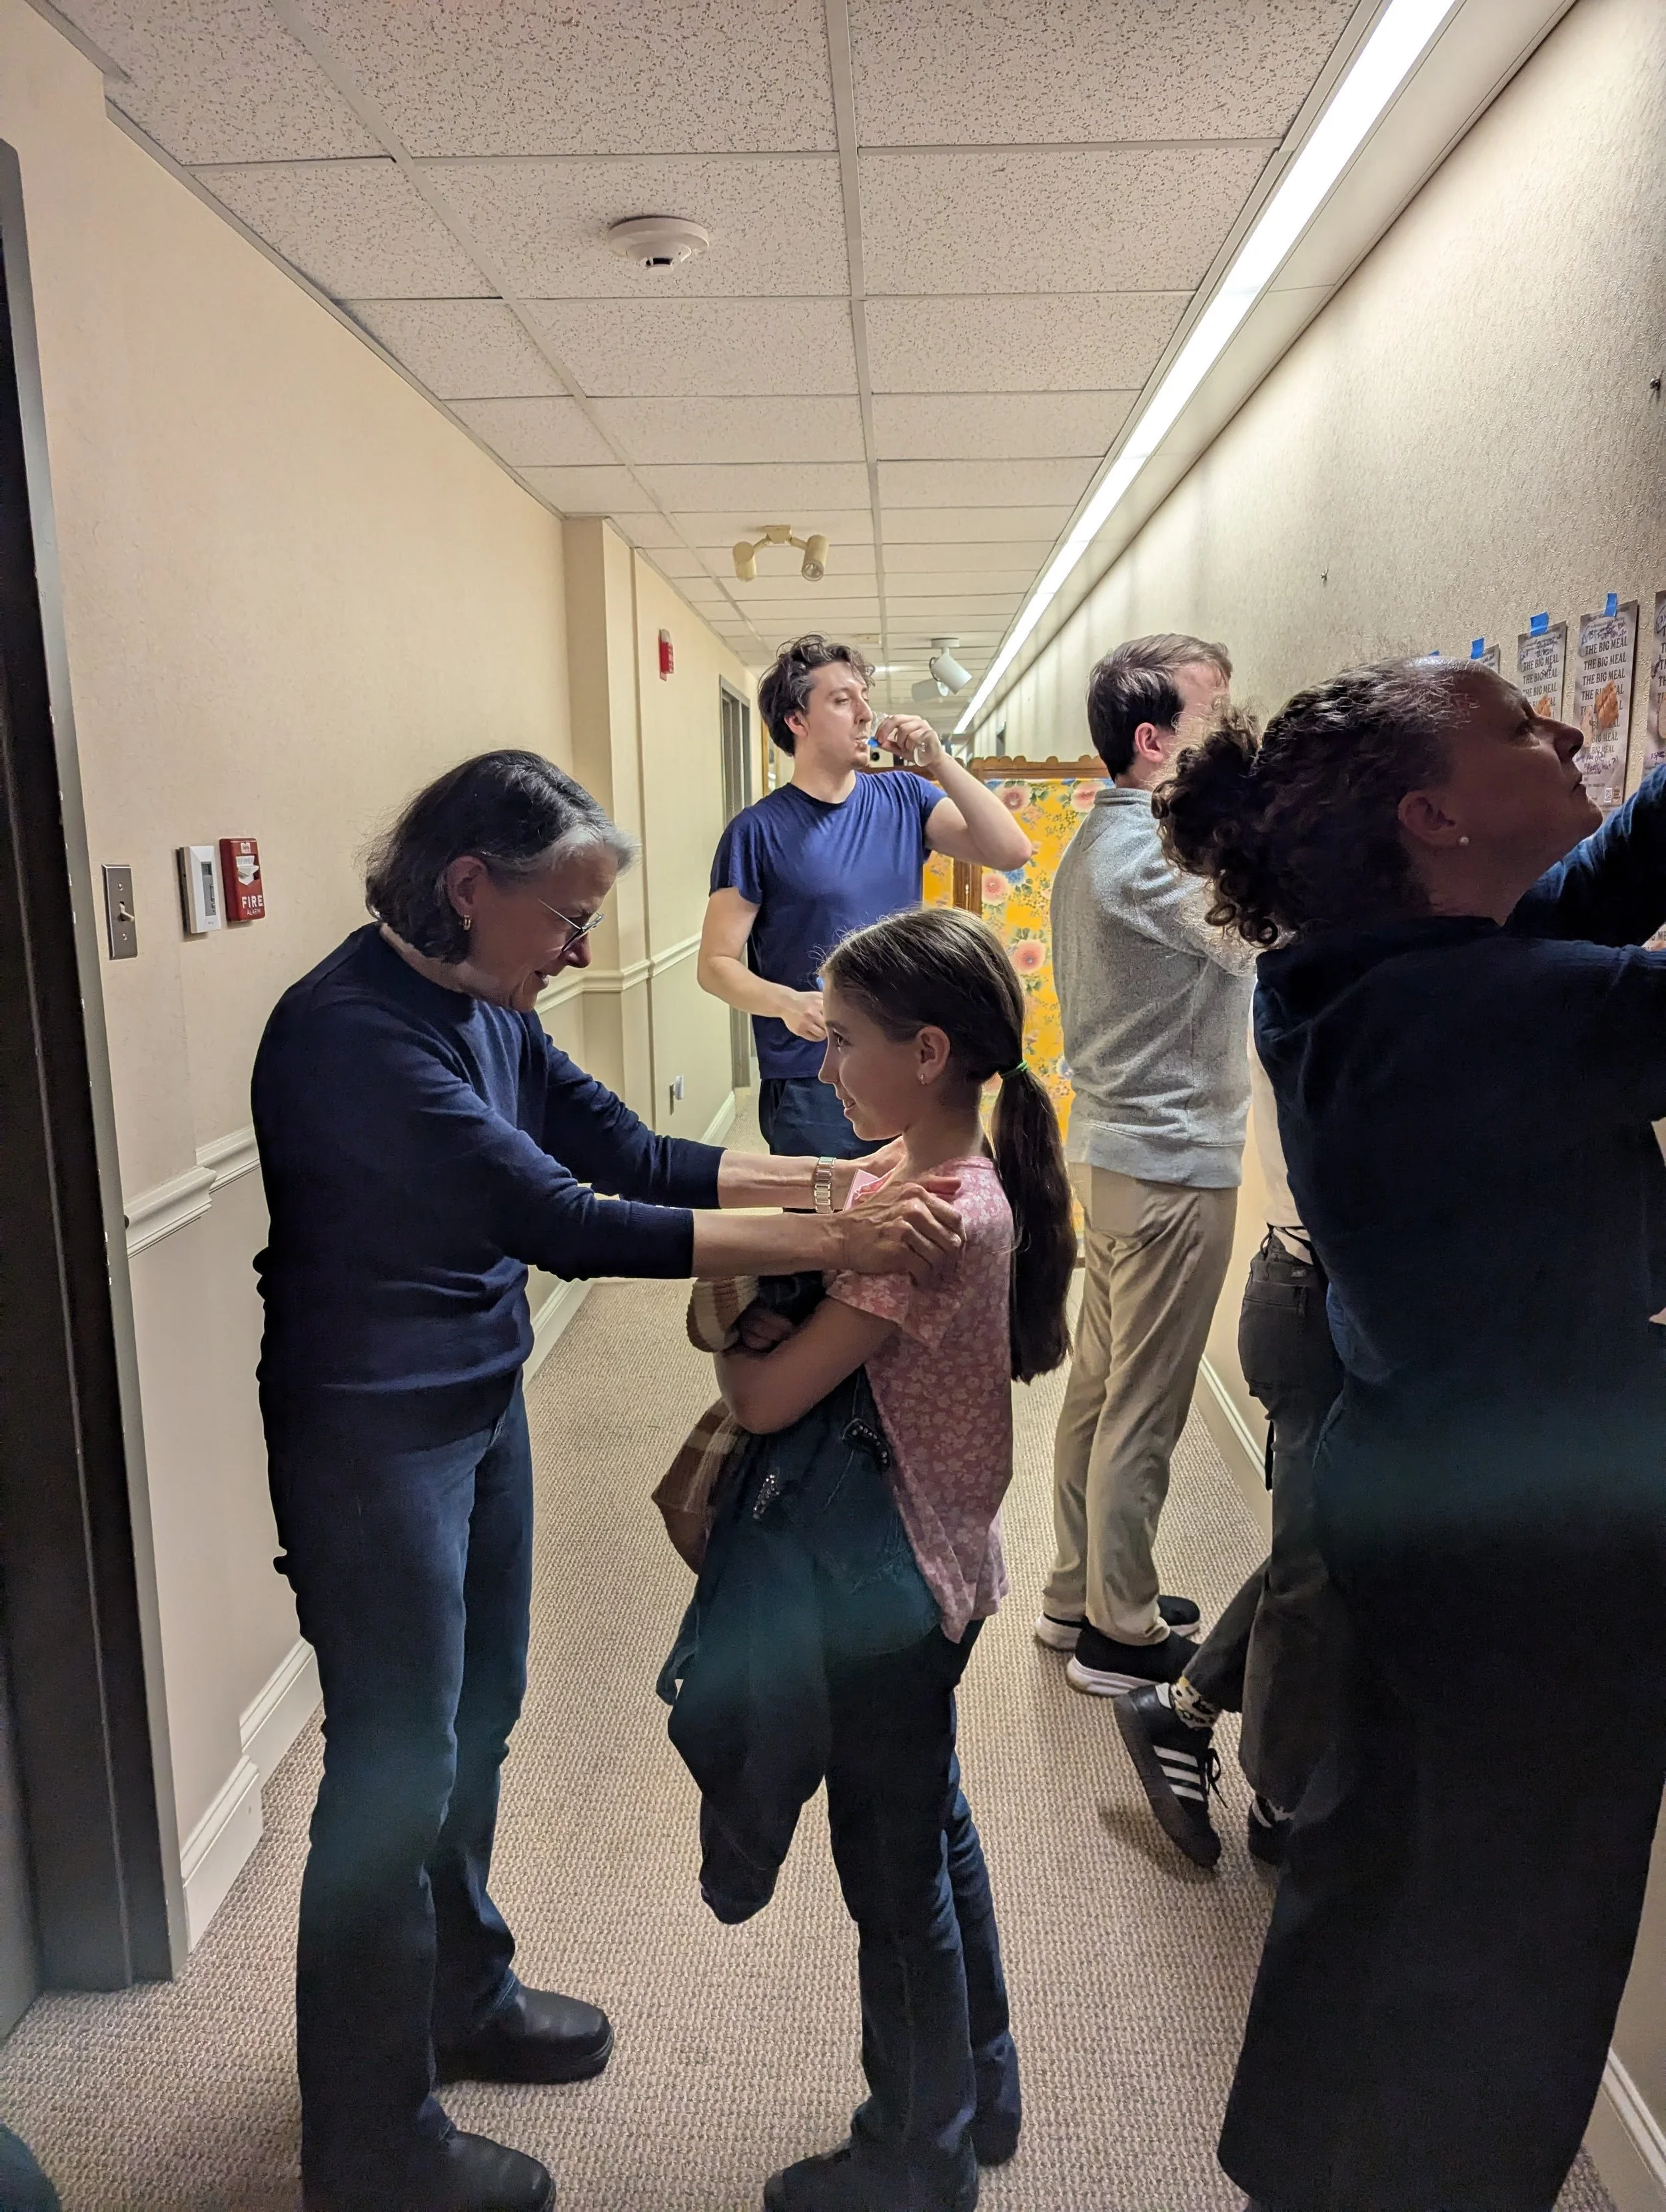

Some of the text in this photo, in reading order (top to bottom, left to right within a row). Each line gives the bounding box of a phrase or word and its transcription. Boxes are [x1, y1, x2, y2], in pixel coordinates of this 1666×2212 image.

[1585, 644, 1597, 656] THE
[1599, 640, 1609, 653] BIG
[1611, 636, 1627, 650] MEAL
[1523, 660, 1533, 671] THE
[1535, 658, 1544, 668] BIG
[1545, 654, 1559, 666] MEAL
[1583, 652, 1626, 671] THE BIG MEAL
[1523, 674, 1533, 685] THE
[1583, 668, 1625, 686] THE BIG MEAL
[1533, 686, 1542, 696] BIG
[1543, 682, 1557, 694] MEAL
[1581, 689, 1594, 701] THE
[1592, 732, 1618, 743] BIG MEAL
[241, 895, 263, 909] FIRE
